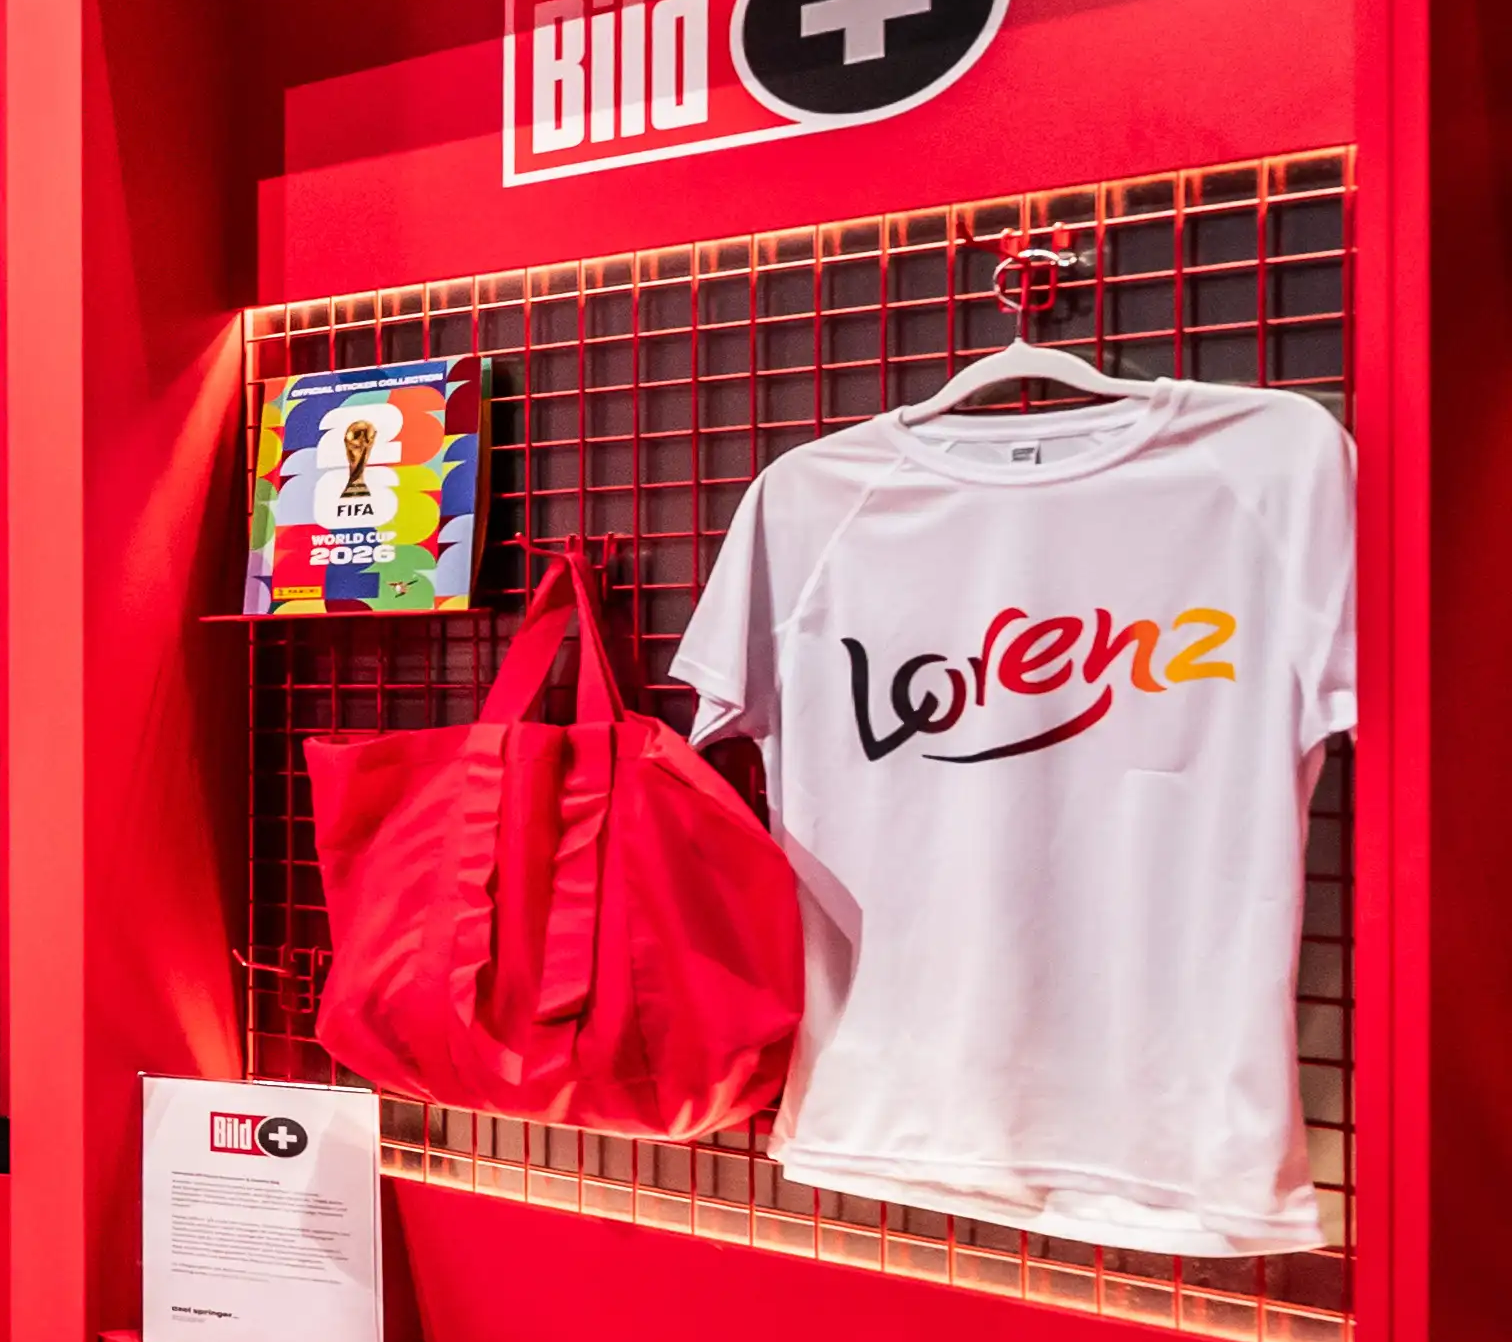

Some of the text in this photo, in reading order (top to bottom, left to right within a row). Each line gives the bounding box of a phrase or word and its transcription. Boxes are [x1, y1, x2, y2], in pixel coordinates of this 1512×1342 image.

[291, 372, 444, 398] OFFICIAL STICKER COLLECTION
[336, 504, 374, 517] FIFA
[311, 531, 397, 546] WORLD CUP
[309, 545, 396, 565] 2026
[213, 1115, 253, 1151] Bild
